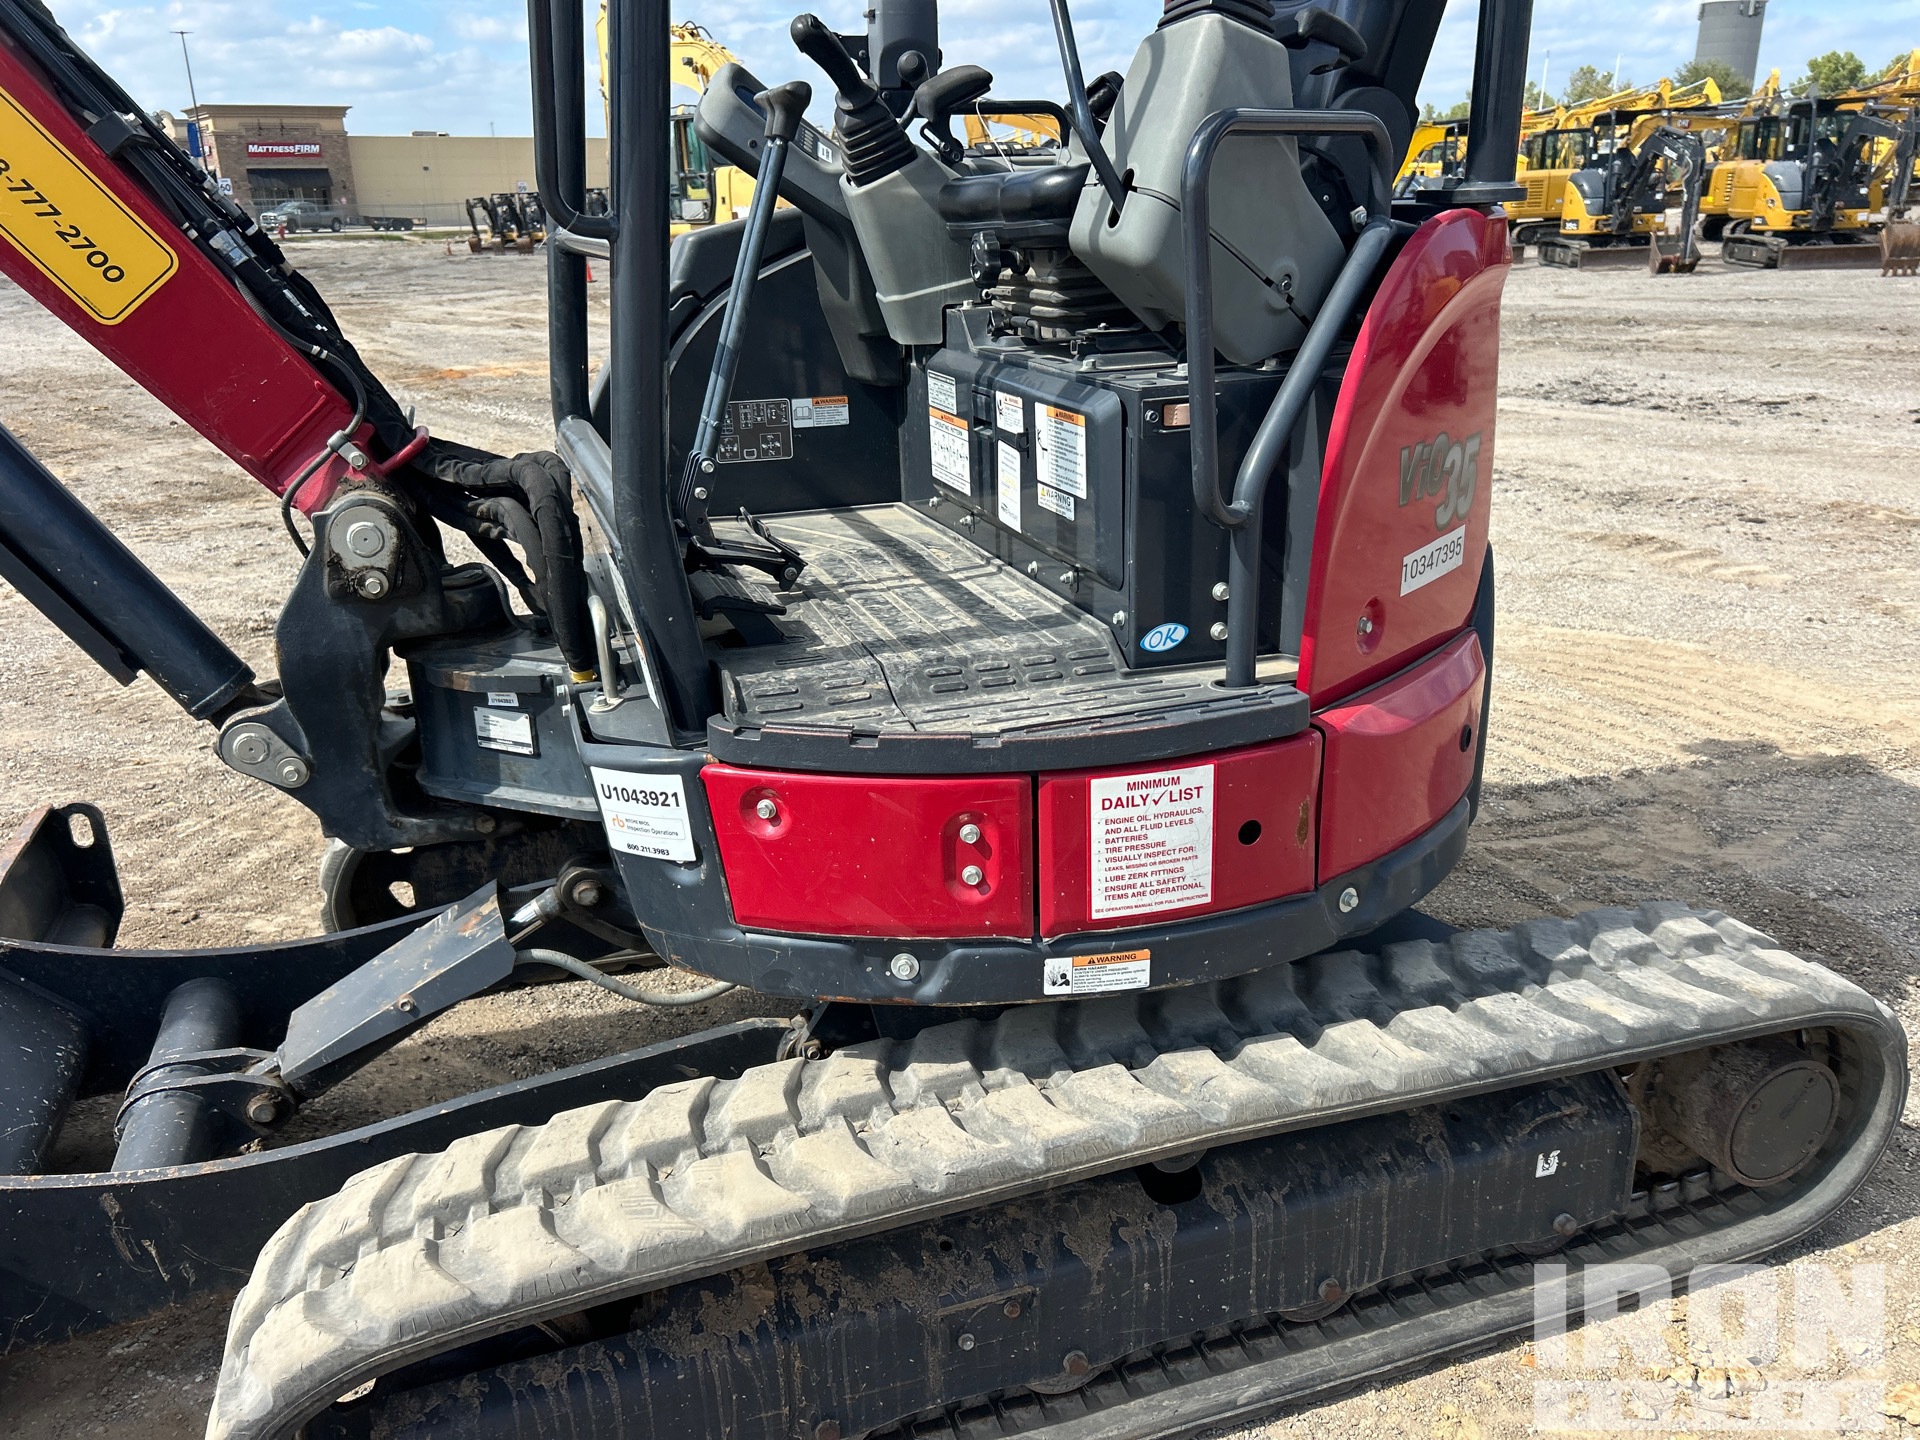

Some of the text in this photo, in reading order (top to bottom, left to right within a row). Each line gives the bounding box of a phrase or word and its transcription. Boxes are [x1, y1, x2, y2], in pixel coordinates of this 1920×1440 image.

[1059, 412, 1074, 422] WARNING
[1046, 489, 1071, 506] WARNING
[1403, 536, 1462, 582] 10347395
[1149, 626, 1180, 648] OK
[1127, 776, 1180, 792] MINIMUM
[600, 783, 680, 807] U1043921
[1102, 786, 1204, 810] DAILY LIST
[1105, 816, 1135, 826] ENGINE
[1153, 807, 1204, 820] HYDRAULICS,
[1140, 823, 1162, 831] FLUID
[1165, 818, 1194, 828] LEVELS
[627, 825, 678, 836] Inspection Operations
[1105, 834, 1148, 844] BATTERIES
[1124, 841, 1166, 852] PRESSURE
[627, 843, 670, 855] 800.211.3983
[1105, 846, 1196, 863] VISUALLY INSPECT FOR:
[1105, 866, 1184, 882] LUBE ZERK FITTINGS
[1105, 876, 1186, 892] ENSURE ALL SAFETY
[1105, 882, 1203, 901] ITEMS ARE OPERATIONAL
[1177, 893, 1208, 902] INSTRUCTIONS
[1096, 953, 1136, 963] WARNING
